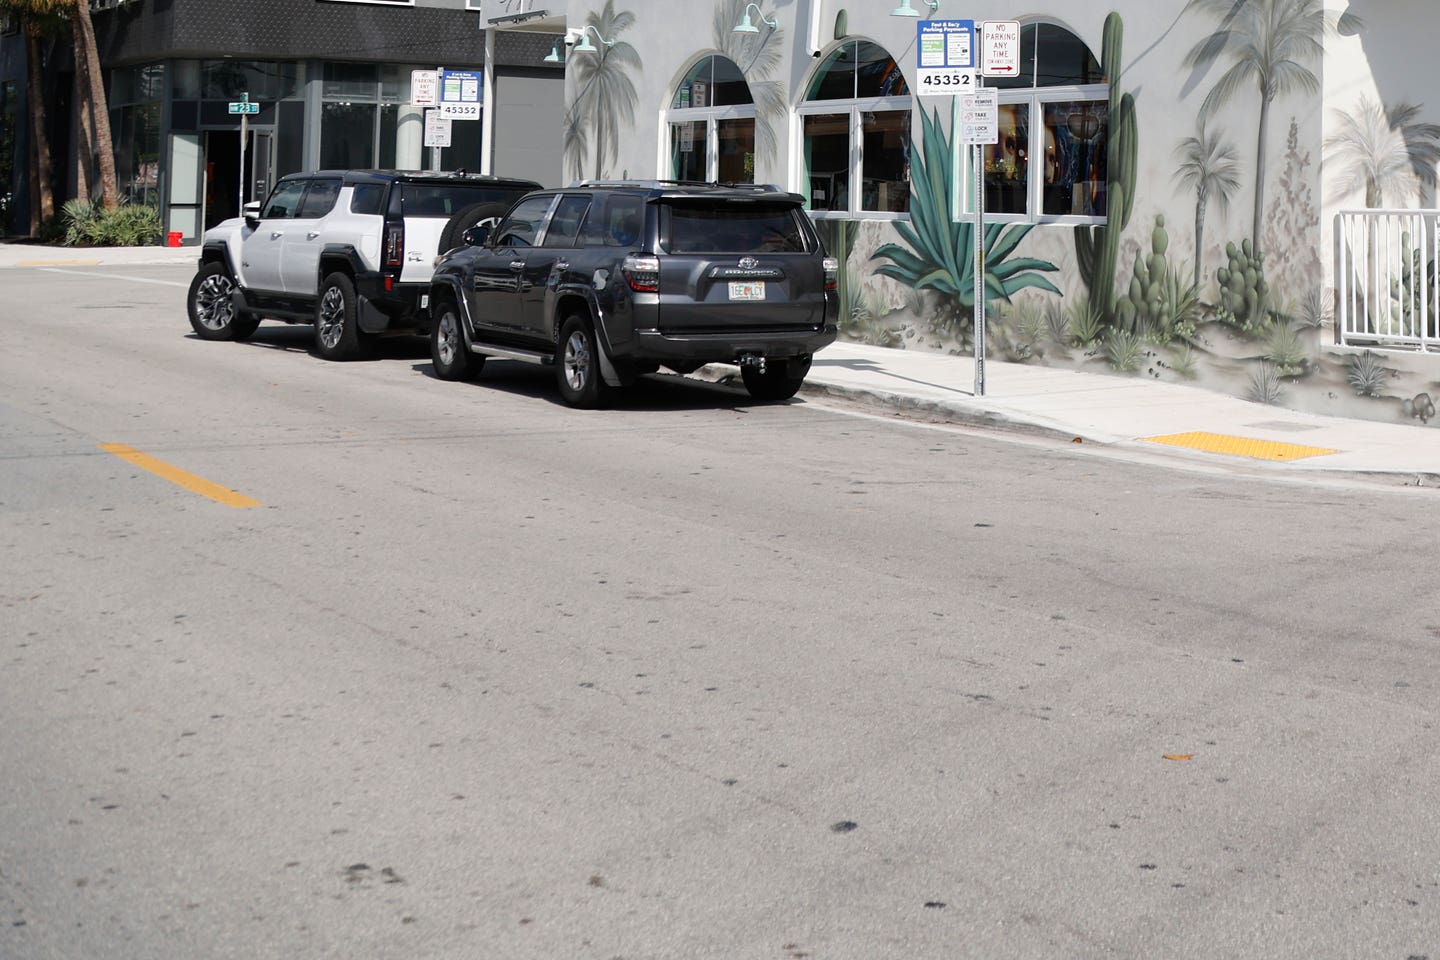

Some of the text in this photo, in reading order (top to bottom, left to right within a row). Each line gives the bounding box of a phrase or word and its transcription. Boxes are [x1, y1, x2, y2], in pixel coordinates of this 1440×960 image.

[996, 23, 1006, 31] NO
[985, 32, 1016, 41] PARKING
[993, 42, 1008, 50] ANY
[993, 50, 1009, 58] TIME
[923, 74, 970, 86] 45352
[239, 104, 250, 114] 23
[445, 106, 476, 115] 45352
